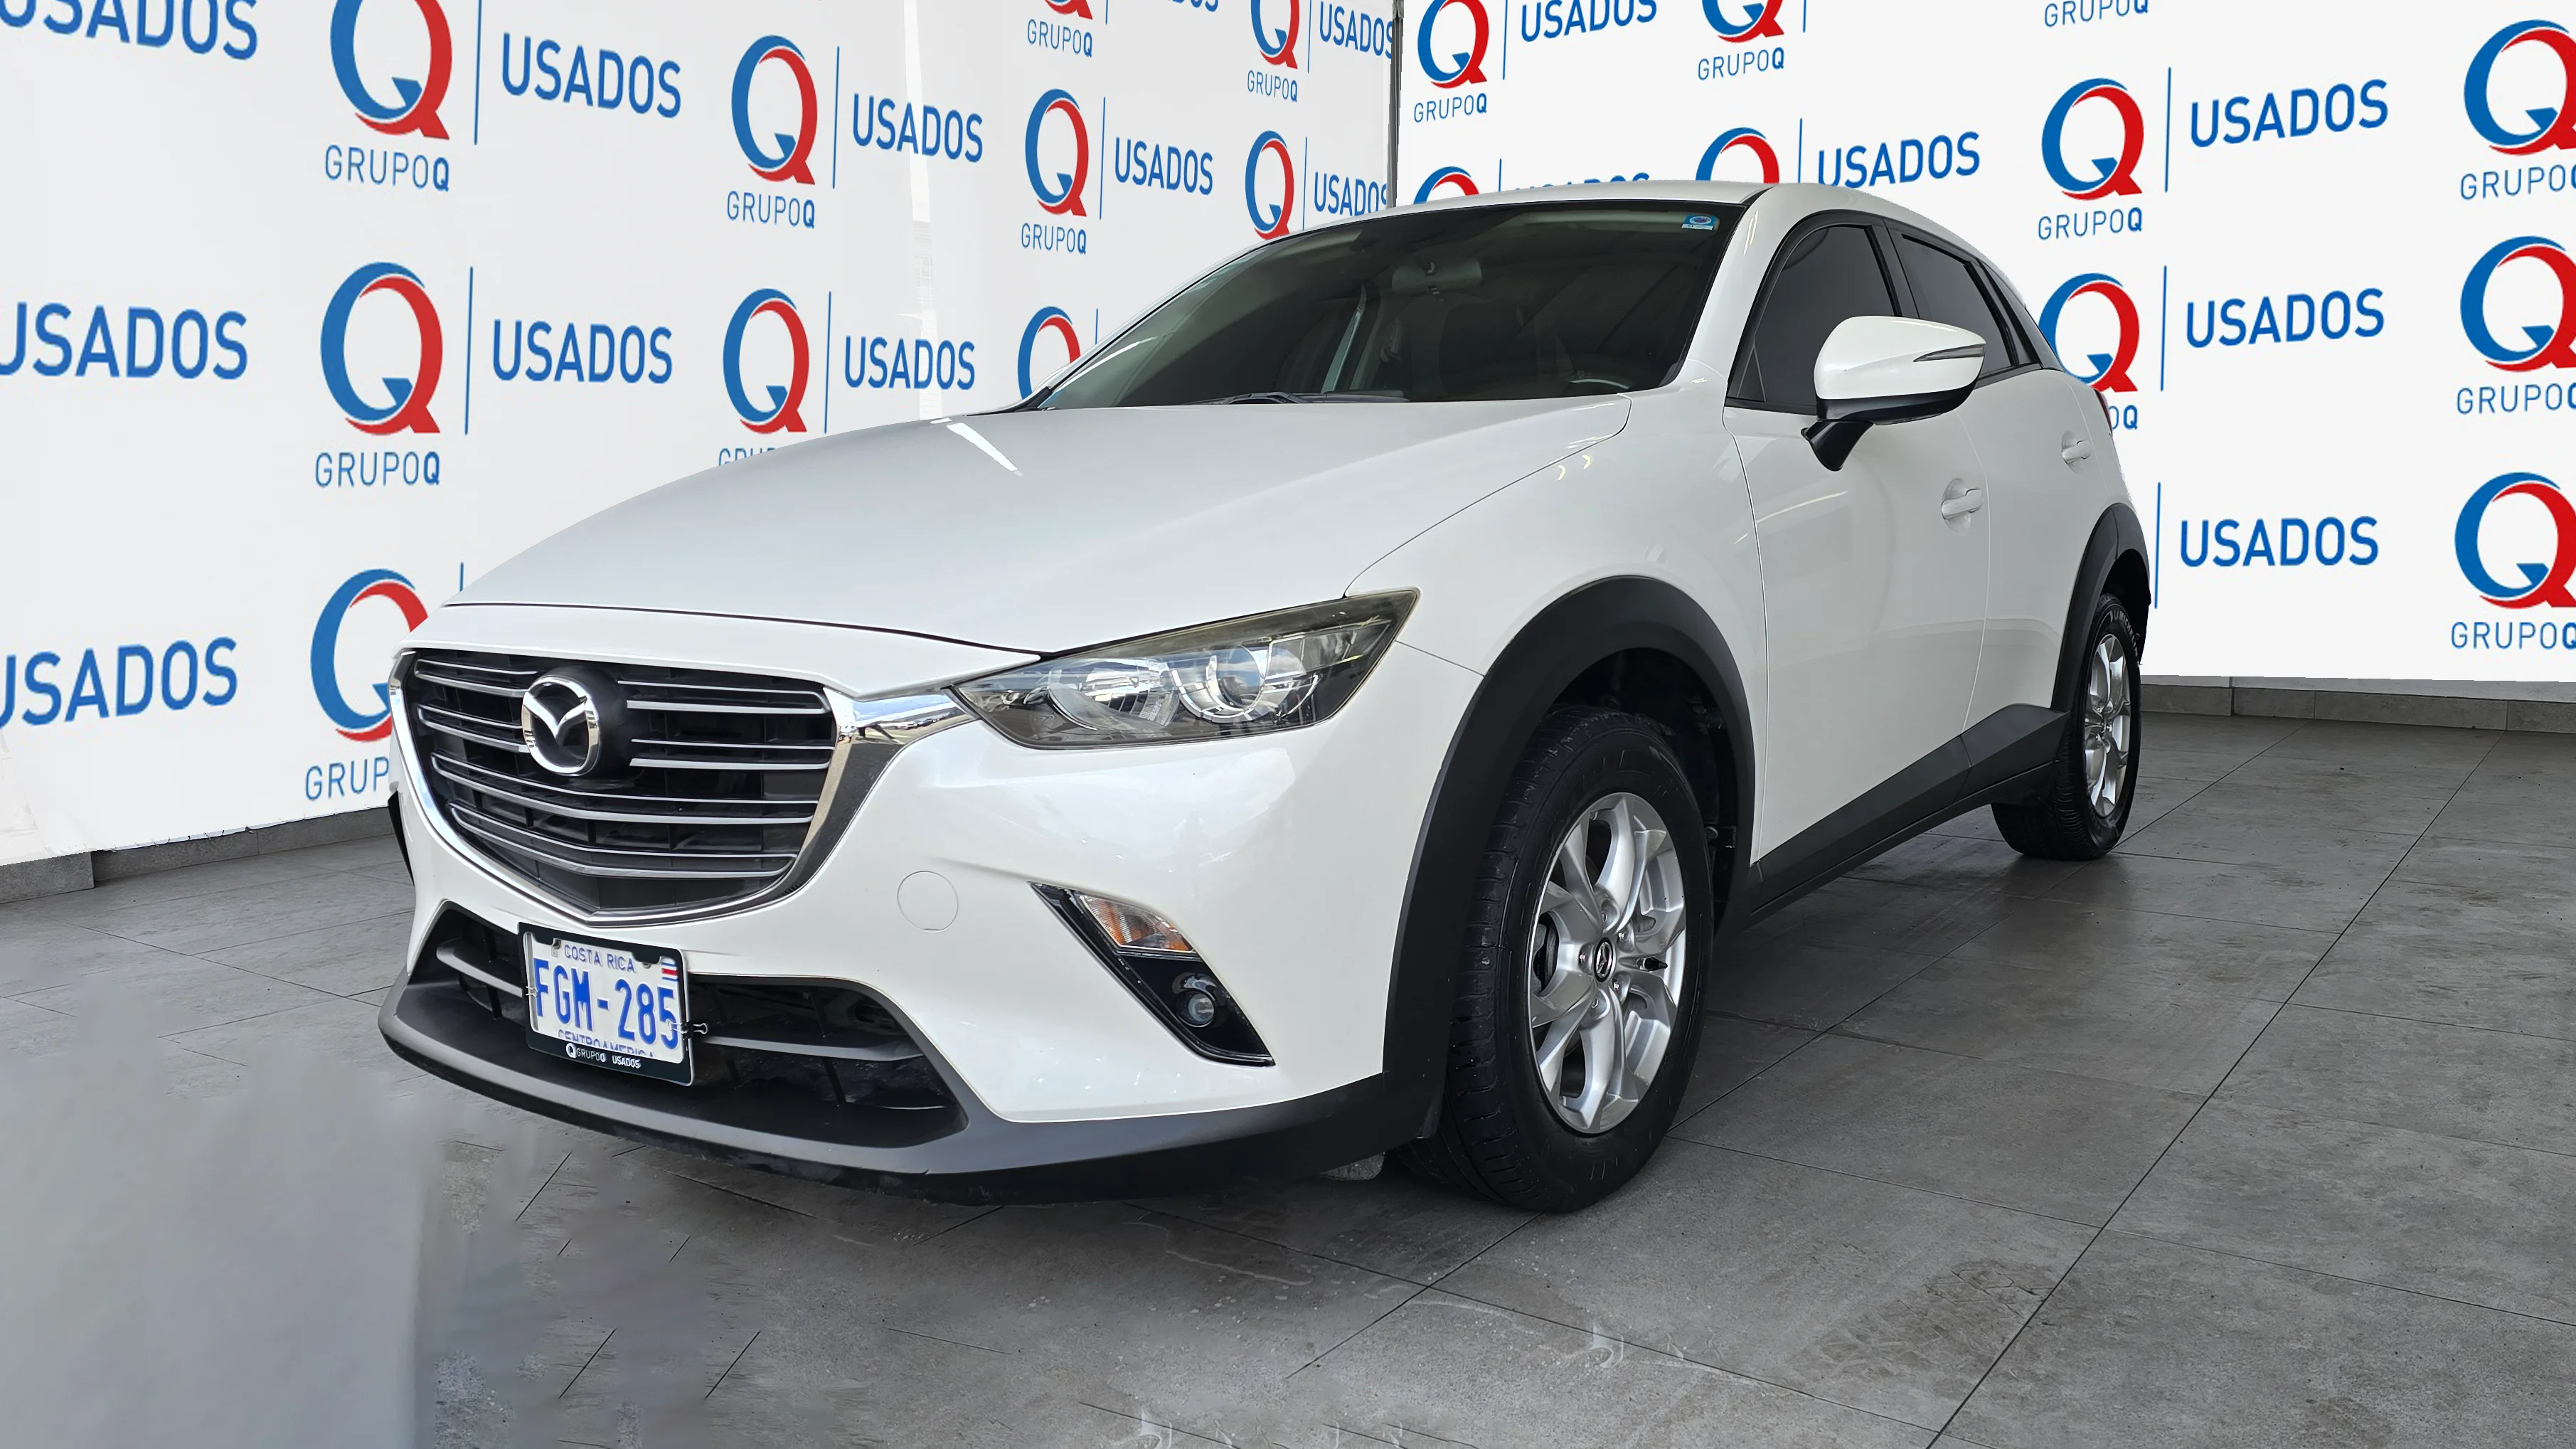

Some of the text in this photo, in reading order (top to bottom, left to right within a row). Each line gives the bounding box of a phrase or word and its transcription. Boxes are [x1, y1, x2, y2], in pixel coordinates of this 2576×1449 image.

[1320, 1, 1392, 59] USADOS
[1521, 0, 1657, 42] USADOS
[2045, 0, 2148, 27] GRUPOQ
[1028, 19, 1092, 57] GRUPOQ
[502, 33, 681, 118] USADOS
[1698, 47, 1784, 81] GRUPOQ
[1247, 70, 1297, 101] GRUPOQ
[853, 93, 983, 163] USADOS
[1414, 92, 1487, 123] GRUPOQ
[2191, 78, 2388, 148] USADOS
[326, 145, 449, 192] GRUPOQ
[1115, 137, 1213, 195] USADOS
[1818, 132, 1980, 189] USADOS
[727, 191, 815, 228] GRUPOQ
[2038, 207, 2142, 239] GRUPOQ
[1021, 223, 1087, 253] GRUPOQ
[2186, 287, 2384, 349] USADOS
[493, 319, 672, 384] USADOS
[845, 336, 975, 390] USADOS
[2457, 382, 2576, 414] GRUPOQ
[316, 451, 440, 487] GRUPOQ
[2181, 516, 2379, 568] USADOS
[2452, 622, 2576, 650] GRUPOQ
[306, 757, 389, 800] GRUP
[564, 944, 636, 974] COSTA RICA
[533, 957, 678, 1050] FGM-285
[612, 1054, 642, 1068] USADOS
